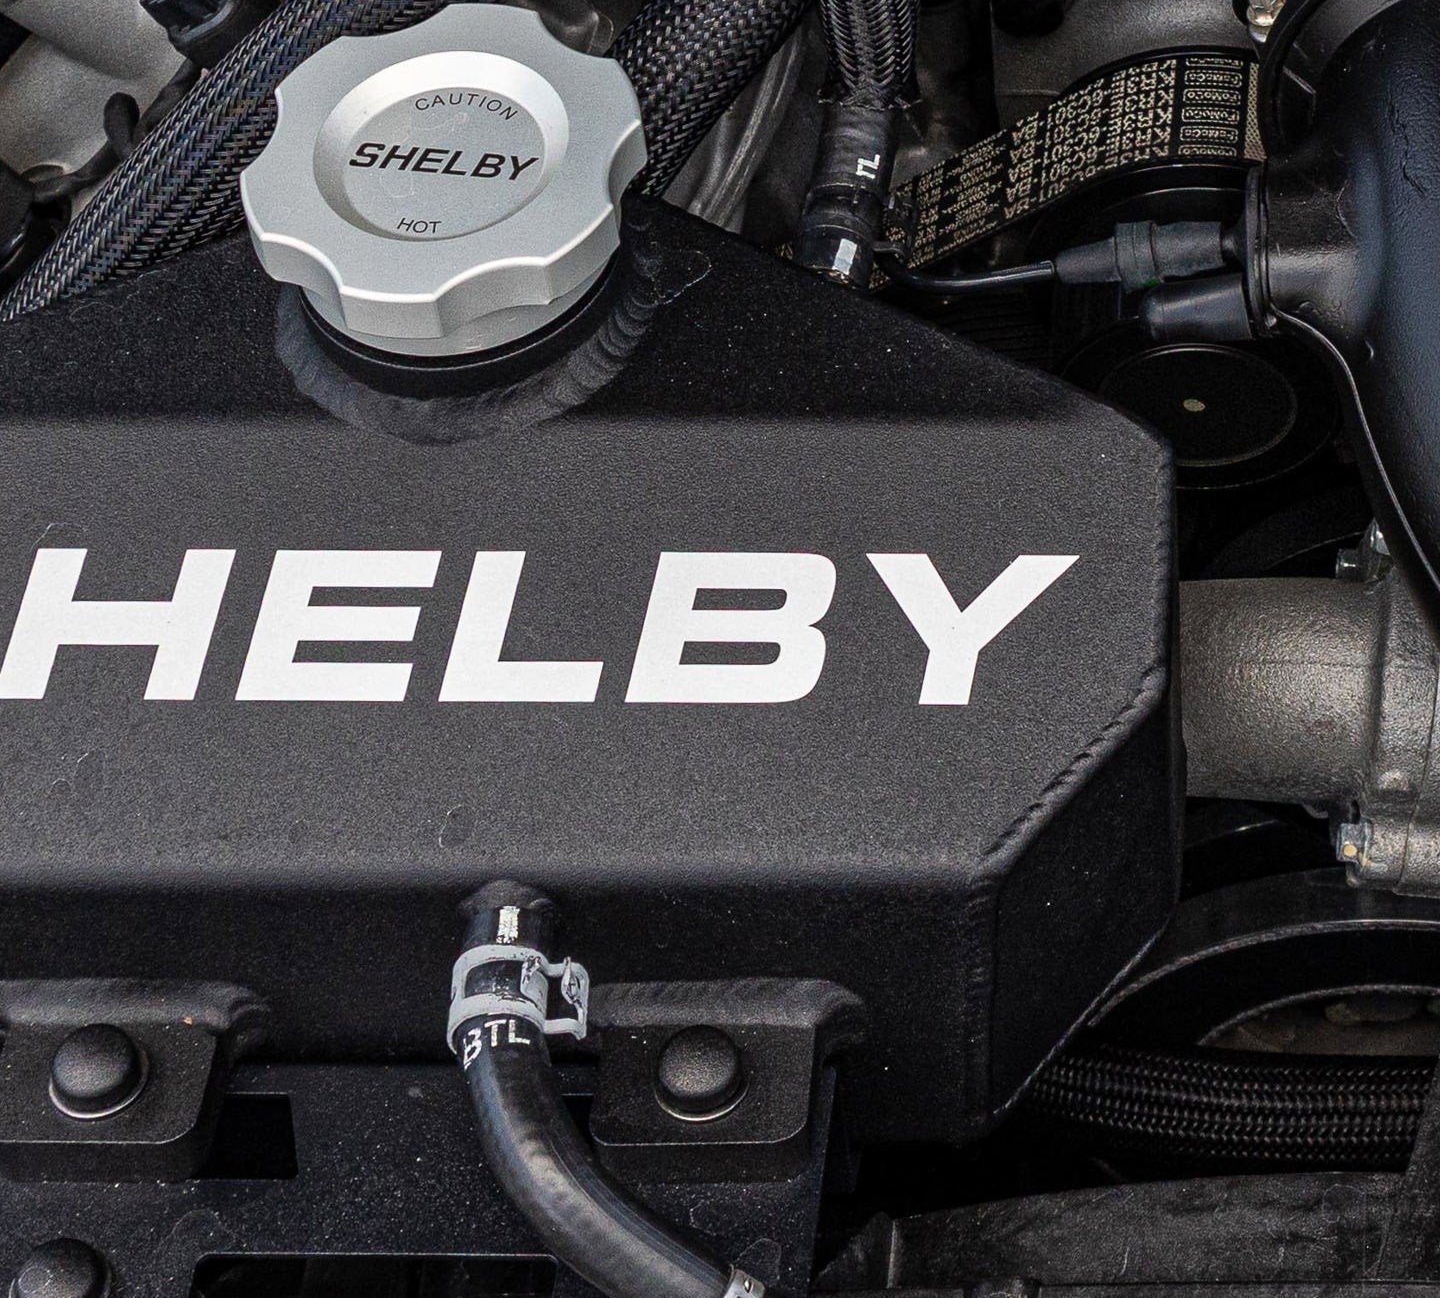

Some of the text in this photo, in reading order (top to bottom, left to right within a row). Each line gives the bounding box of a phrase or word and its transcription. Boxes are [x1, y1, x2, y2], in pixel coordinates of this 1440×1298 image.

[414, 92, 519, 121] CAUTION
[348, 143, 540, 182] SHELBY
[396, 216, 442, 235] HOT
